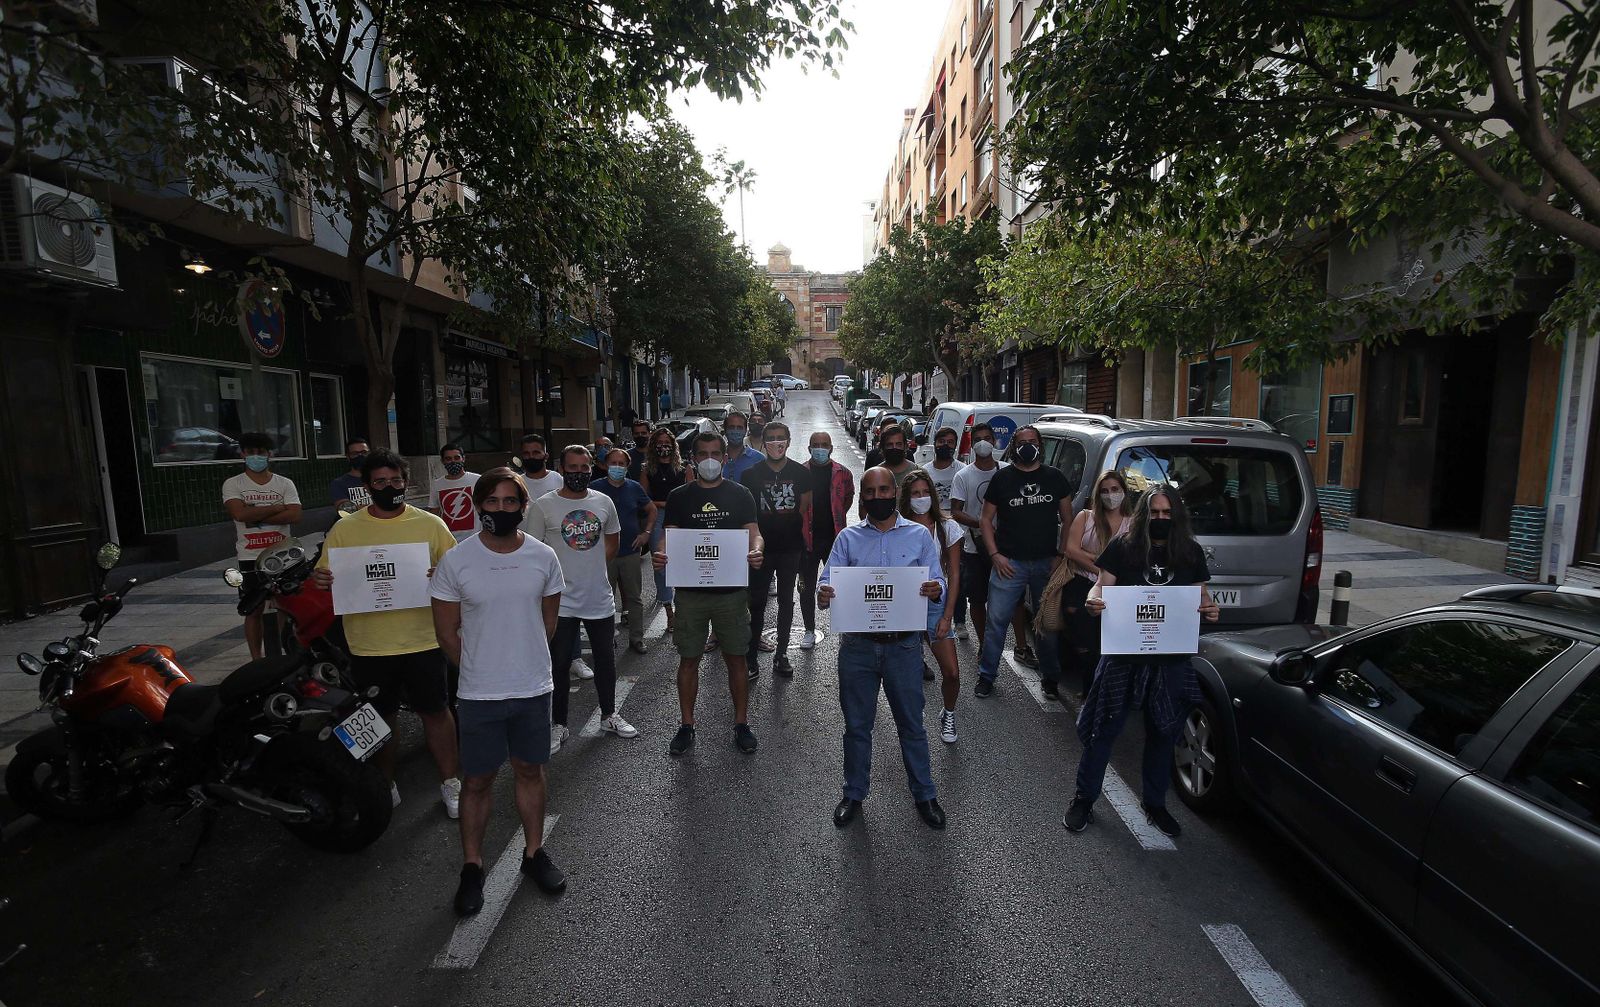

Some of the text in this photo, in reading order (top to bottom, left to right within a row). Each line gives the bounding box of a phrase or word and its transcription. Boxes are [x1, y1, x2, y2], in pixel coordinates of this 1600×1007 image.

[565, 520, 599, 537] Sixties
[1212, 591, 1237, 604] KVV
[344, 708, 376, 737] 0320
[355, 725, 379, 750] GDY
